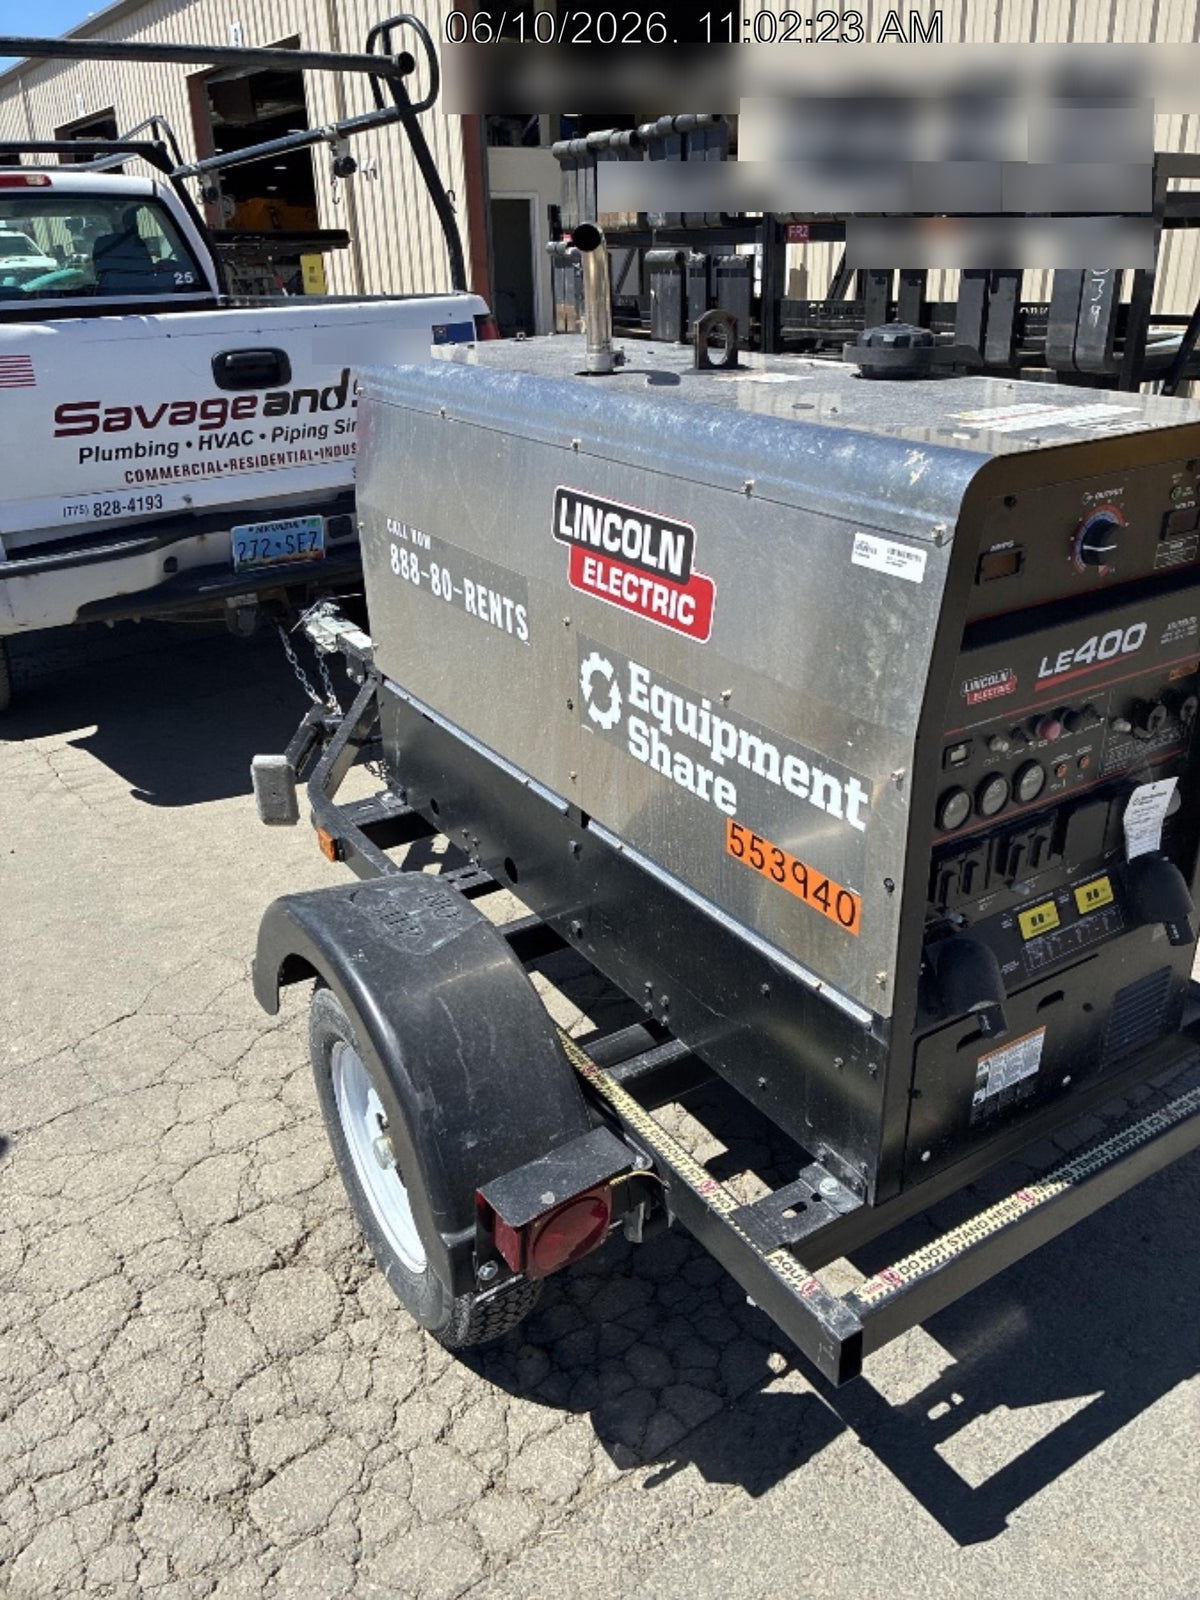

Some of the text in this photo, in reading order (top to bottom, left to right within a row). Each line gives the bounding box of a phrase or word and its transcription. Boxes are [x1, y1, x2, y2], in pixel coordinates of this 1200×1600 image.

[173, 272, 194, 285] 25
[54, 396, 258, 436] Savage
[79, 440, 179, 464] Plumbing
[199, 431, 254, 450] HVAC
[271, 423, 328, 443] Piping
[94, 494, 163, 518] 828-4193
[386, 518, 431, 550] CALL NOW
[559, 497, 685, 577] LINCOLN
[390, 543, 529, 641] 888-80-RENTS
[582, 556, 696, 626] ELECTRIC
[964, 670, 1009, 692] LINCOLN
[1037, 622, 1147, 678] LE400
[628, 661, 868, 831] Equipment
[628, 716, 737, 816] Share
[729, 823, 856, 927] 553940
[712, 1191, 732, 1210] NO
[773, 1252, 805, 1284] AQUI
[898, 1258, 922, 1279] DO
[919, 1242, 949, 1266] NOT
[947, 1217, 990, 1249] STAND
[987, 1198, 1023, 1225] HERE
